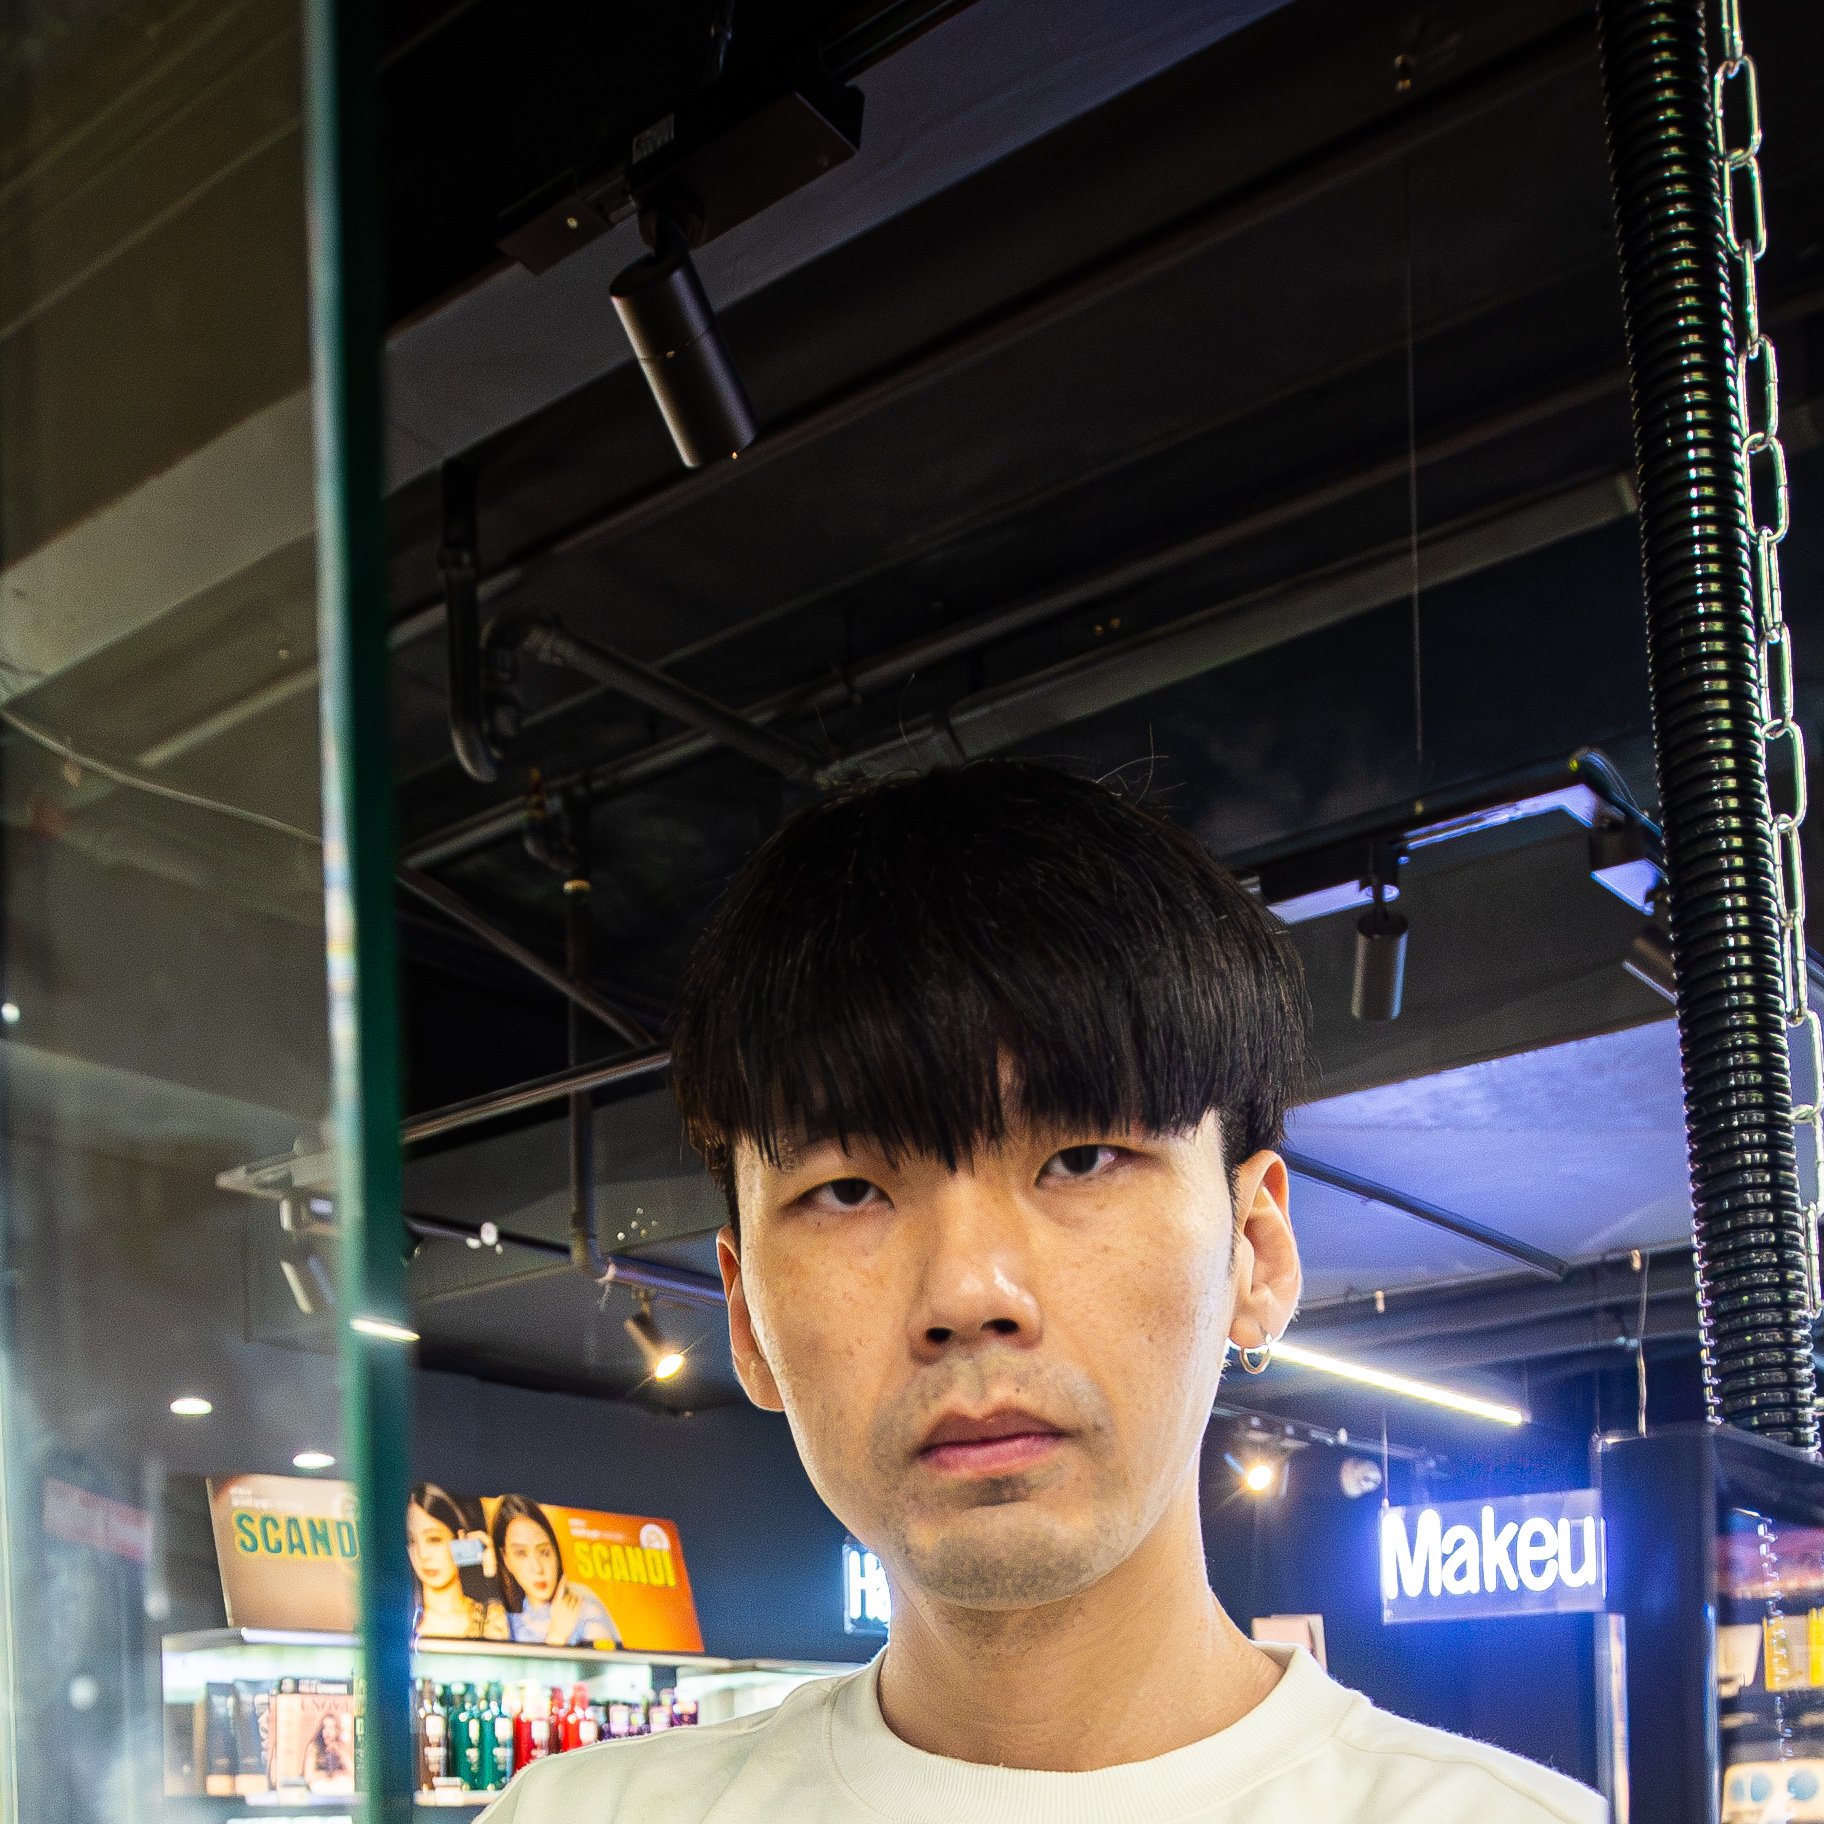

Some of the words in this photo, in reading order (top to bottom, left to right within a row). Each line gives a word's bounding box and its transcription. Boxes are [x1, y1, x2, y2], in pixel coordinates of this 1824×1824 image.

[233, 1510, 362, 1560] SCAND
[1381, 1505, 1598, 1599] Makeu
[573, 1540, 676, 1588] SCANDI
